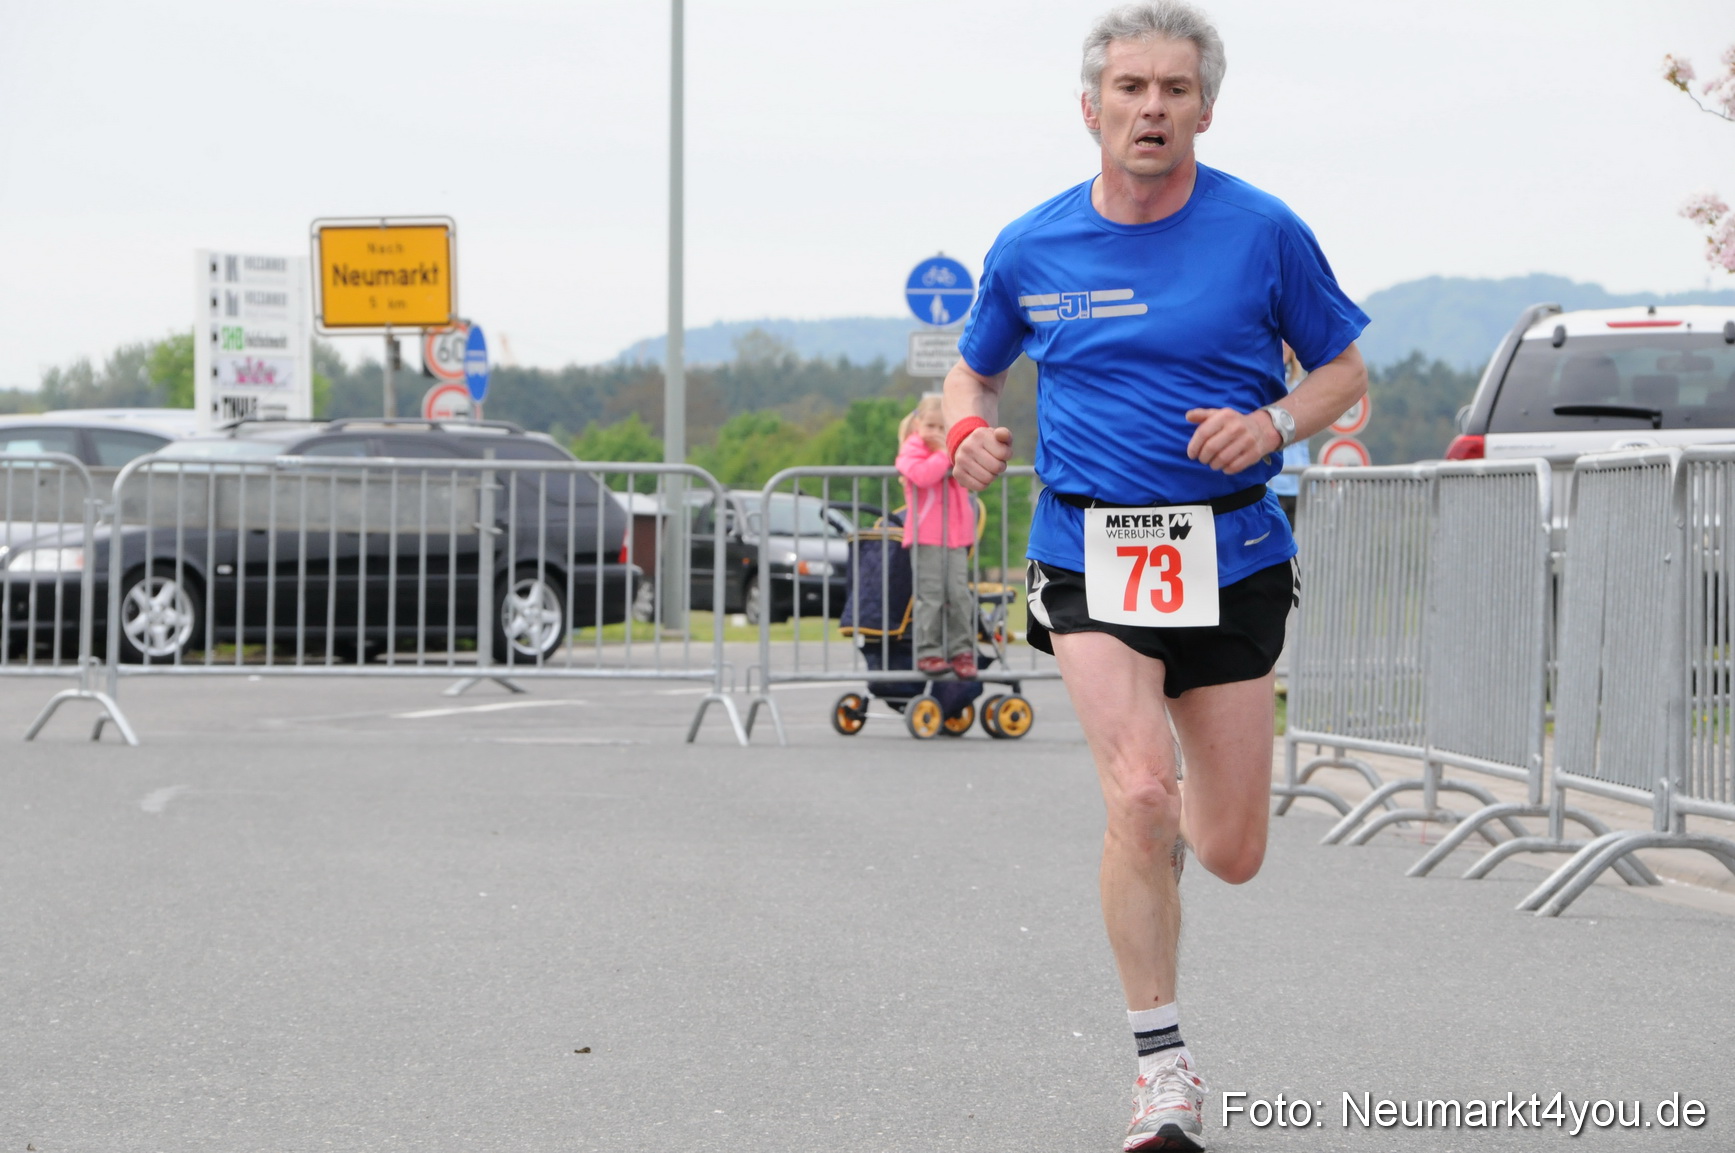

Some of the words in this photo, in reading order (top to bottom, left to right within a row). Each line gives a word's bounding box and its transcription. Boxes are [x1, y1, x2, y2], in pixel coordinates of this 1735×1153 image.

[332, 263, 440, 287] Neumarkt
[1106, 514, 1164, 528] MEYER
[1106, 528, 1166, 539] WERBUNG
[1116, 544, 1184, 614] 73
